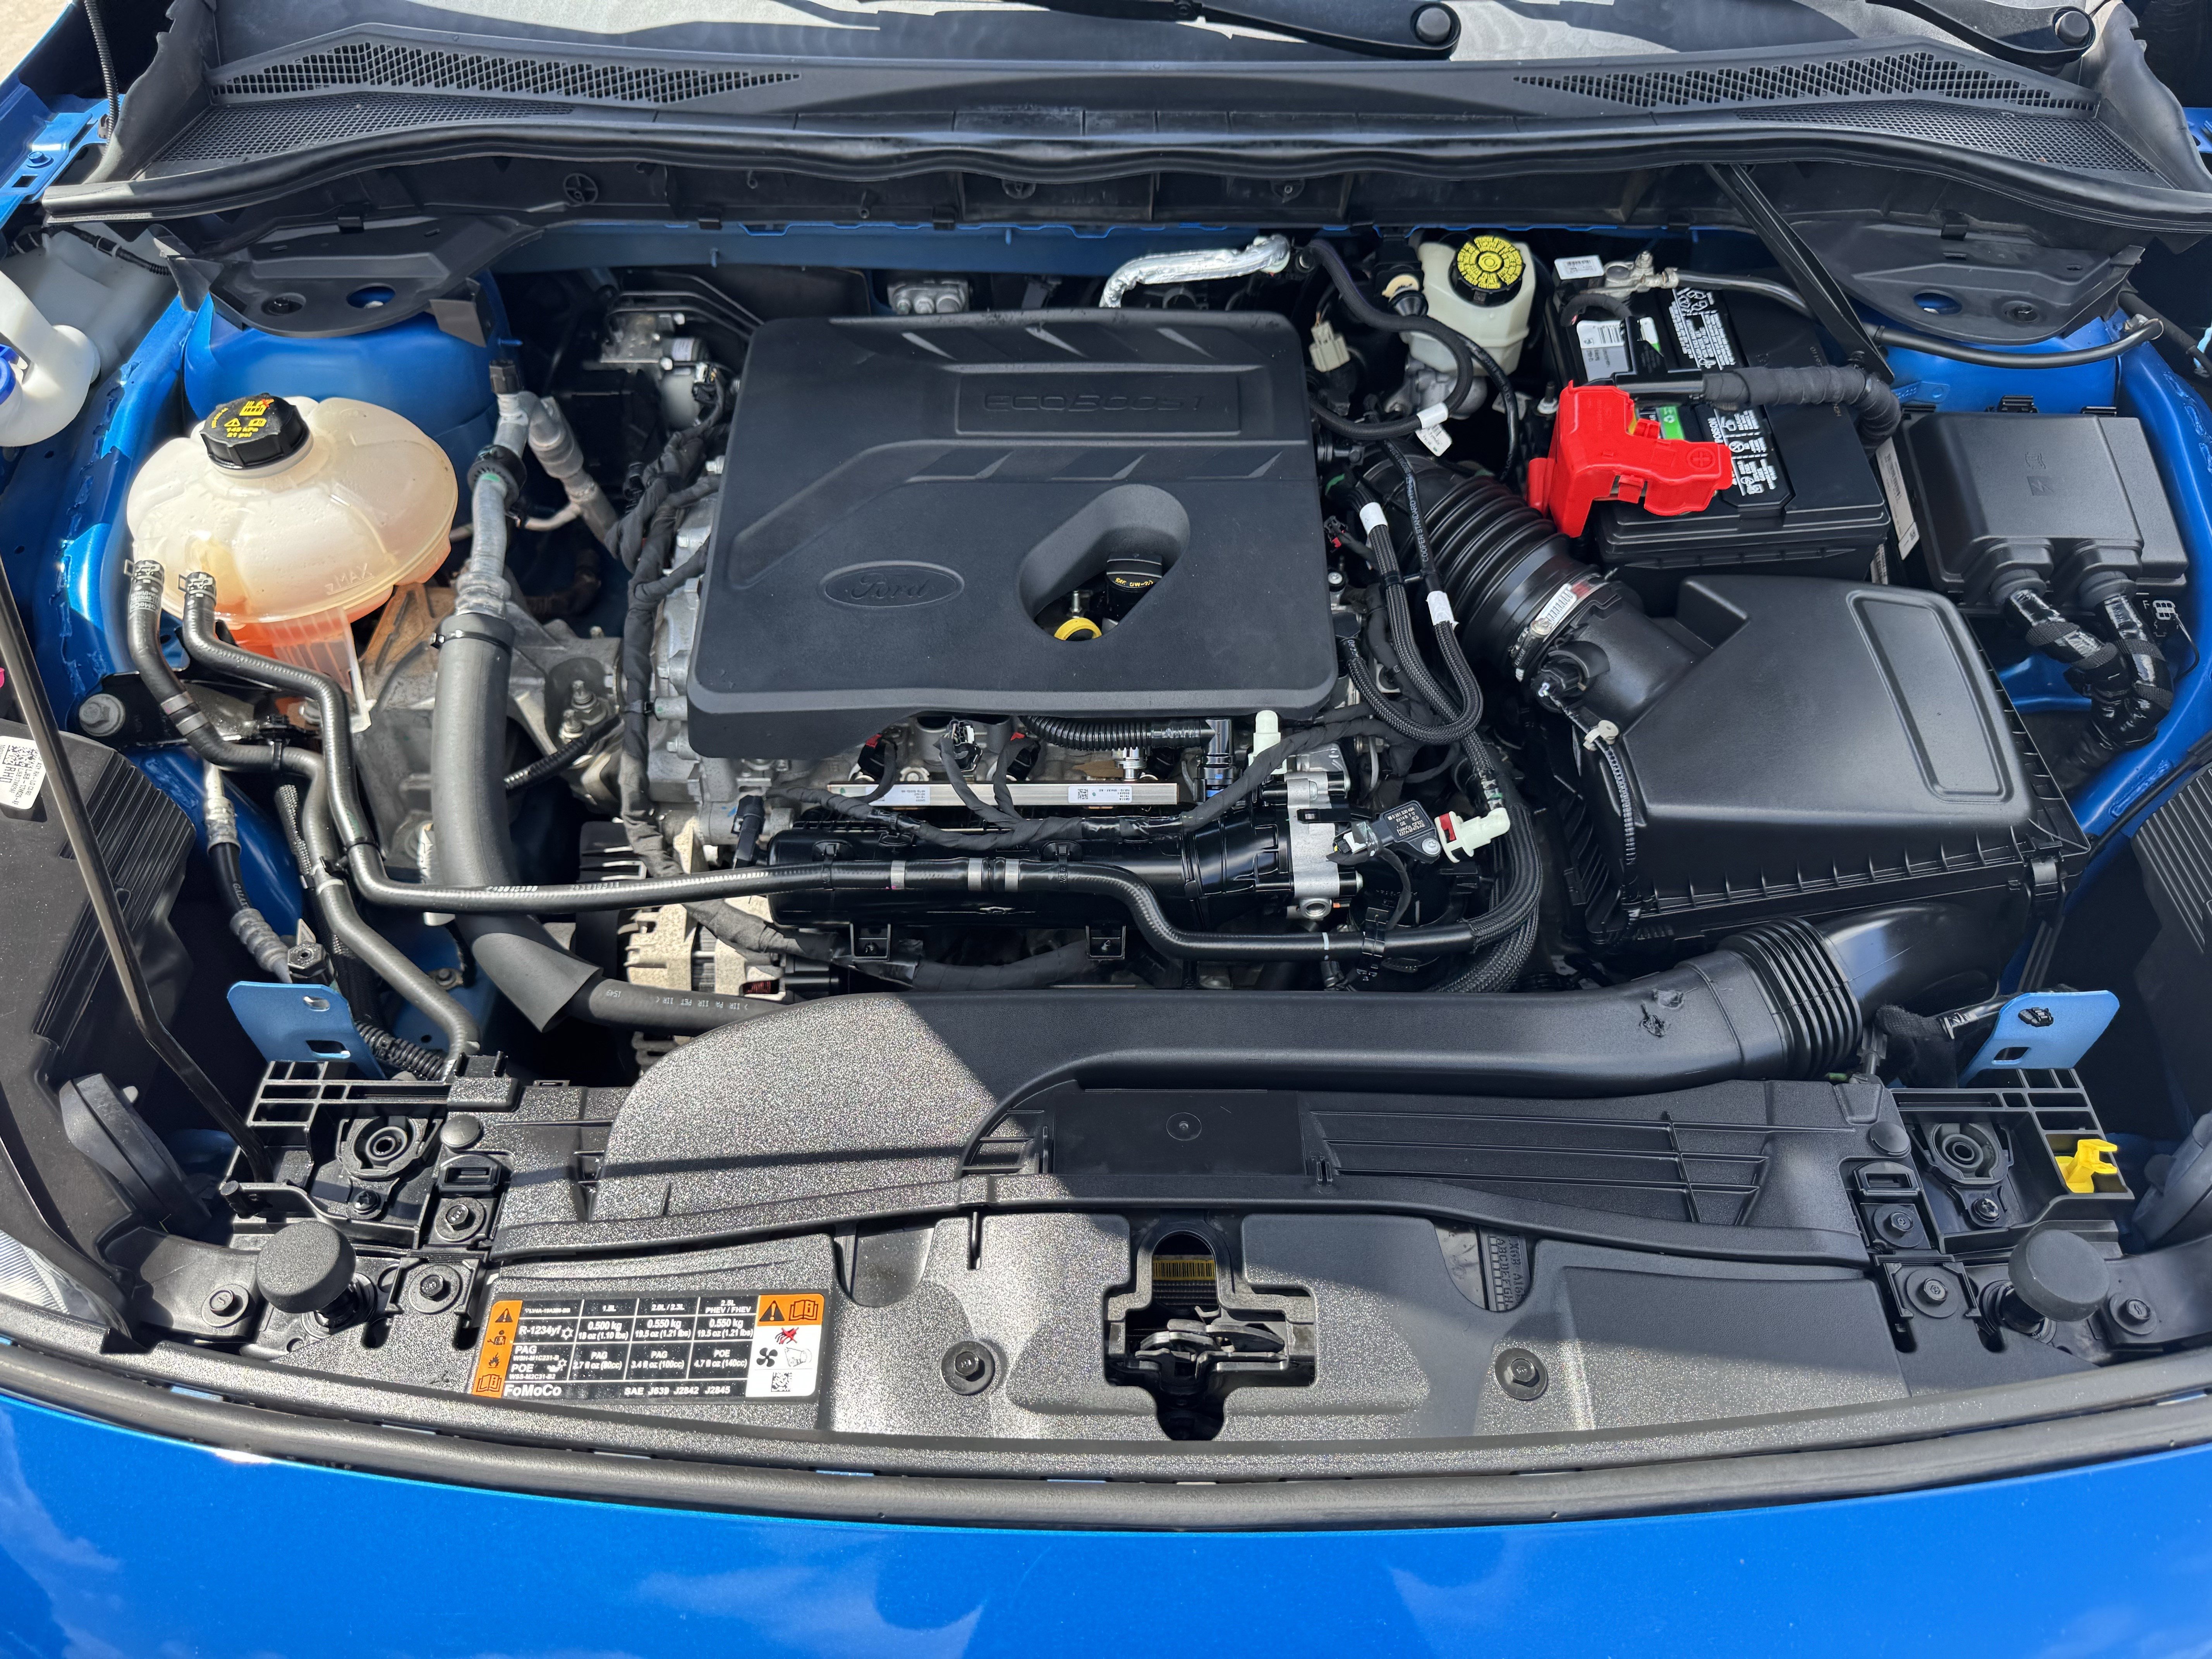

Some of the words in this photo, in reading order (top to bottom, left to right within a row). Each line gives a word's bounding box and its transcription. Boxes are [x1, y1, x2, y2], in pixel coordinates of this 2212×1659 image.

[851, 572, 930, 600] Ford
[587, 1321, 610, 1331] 0.500
[611, 1321, 622, 1332] kg
[647, 1319, 669, 1328] 0.550
[670, 1319, 682, 1330] kg
[709, 1318, 732, 1328] 0.550
[732, 1318, 744, 1329] kg
[519, 1325, 562, 1337] R-1234yf
[597, 1331, 615, 1341] (1.10
[615, 1331, 629, 1340] lbs)
[635, 1329, 649, 1338] 19.5
[659, 1329, 676, 1339] (1.21
[677, 1329, 691, 1338] lbs)
[697, 1329, 712, 1337] 19.5
[721, 1329, 738, 1338] (1.21
[739, 1328, 754, 1338] lbs)
[515, 1345, 537, 1354] PAG
[651, 1350, 668, 1359] PAG
[714, 1349, 731, 1358] POE
[591, 1351, 608, 1360] PAG
[511, 1364, 534, 1372] POE
[573, 1361, 584, 1370] 2.7
[631, 1360, 642, 1369] 3.4
[642, 1360, 648, 1369] fl
[658, 1360, 685, 1370] (100cc)
[693, 1359, 705, 1368] 4.7
[721, 1358, 747, 1369] (140cc)
[503, 1384, 562, 1396] FoMoCo
[624, 1387, 644, 1395] SAE
[648, 1386, 670, 1395] J639
[673, 1386, 699, 1395] J2842
[704, 1386, 731, 1394] J2845
